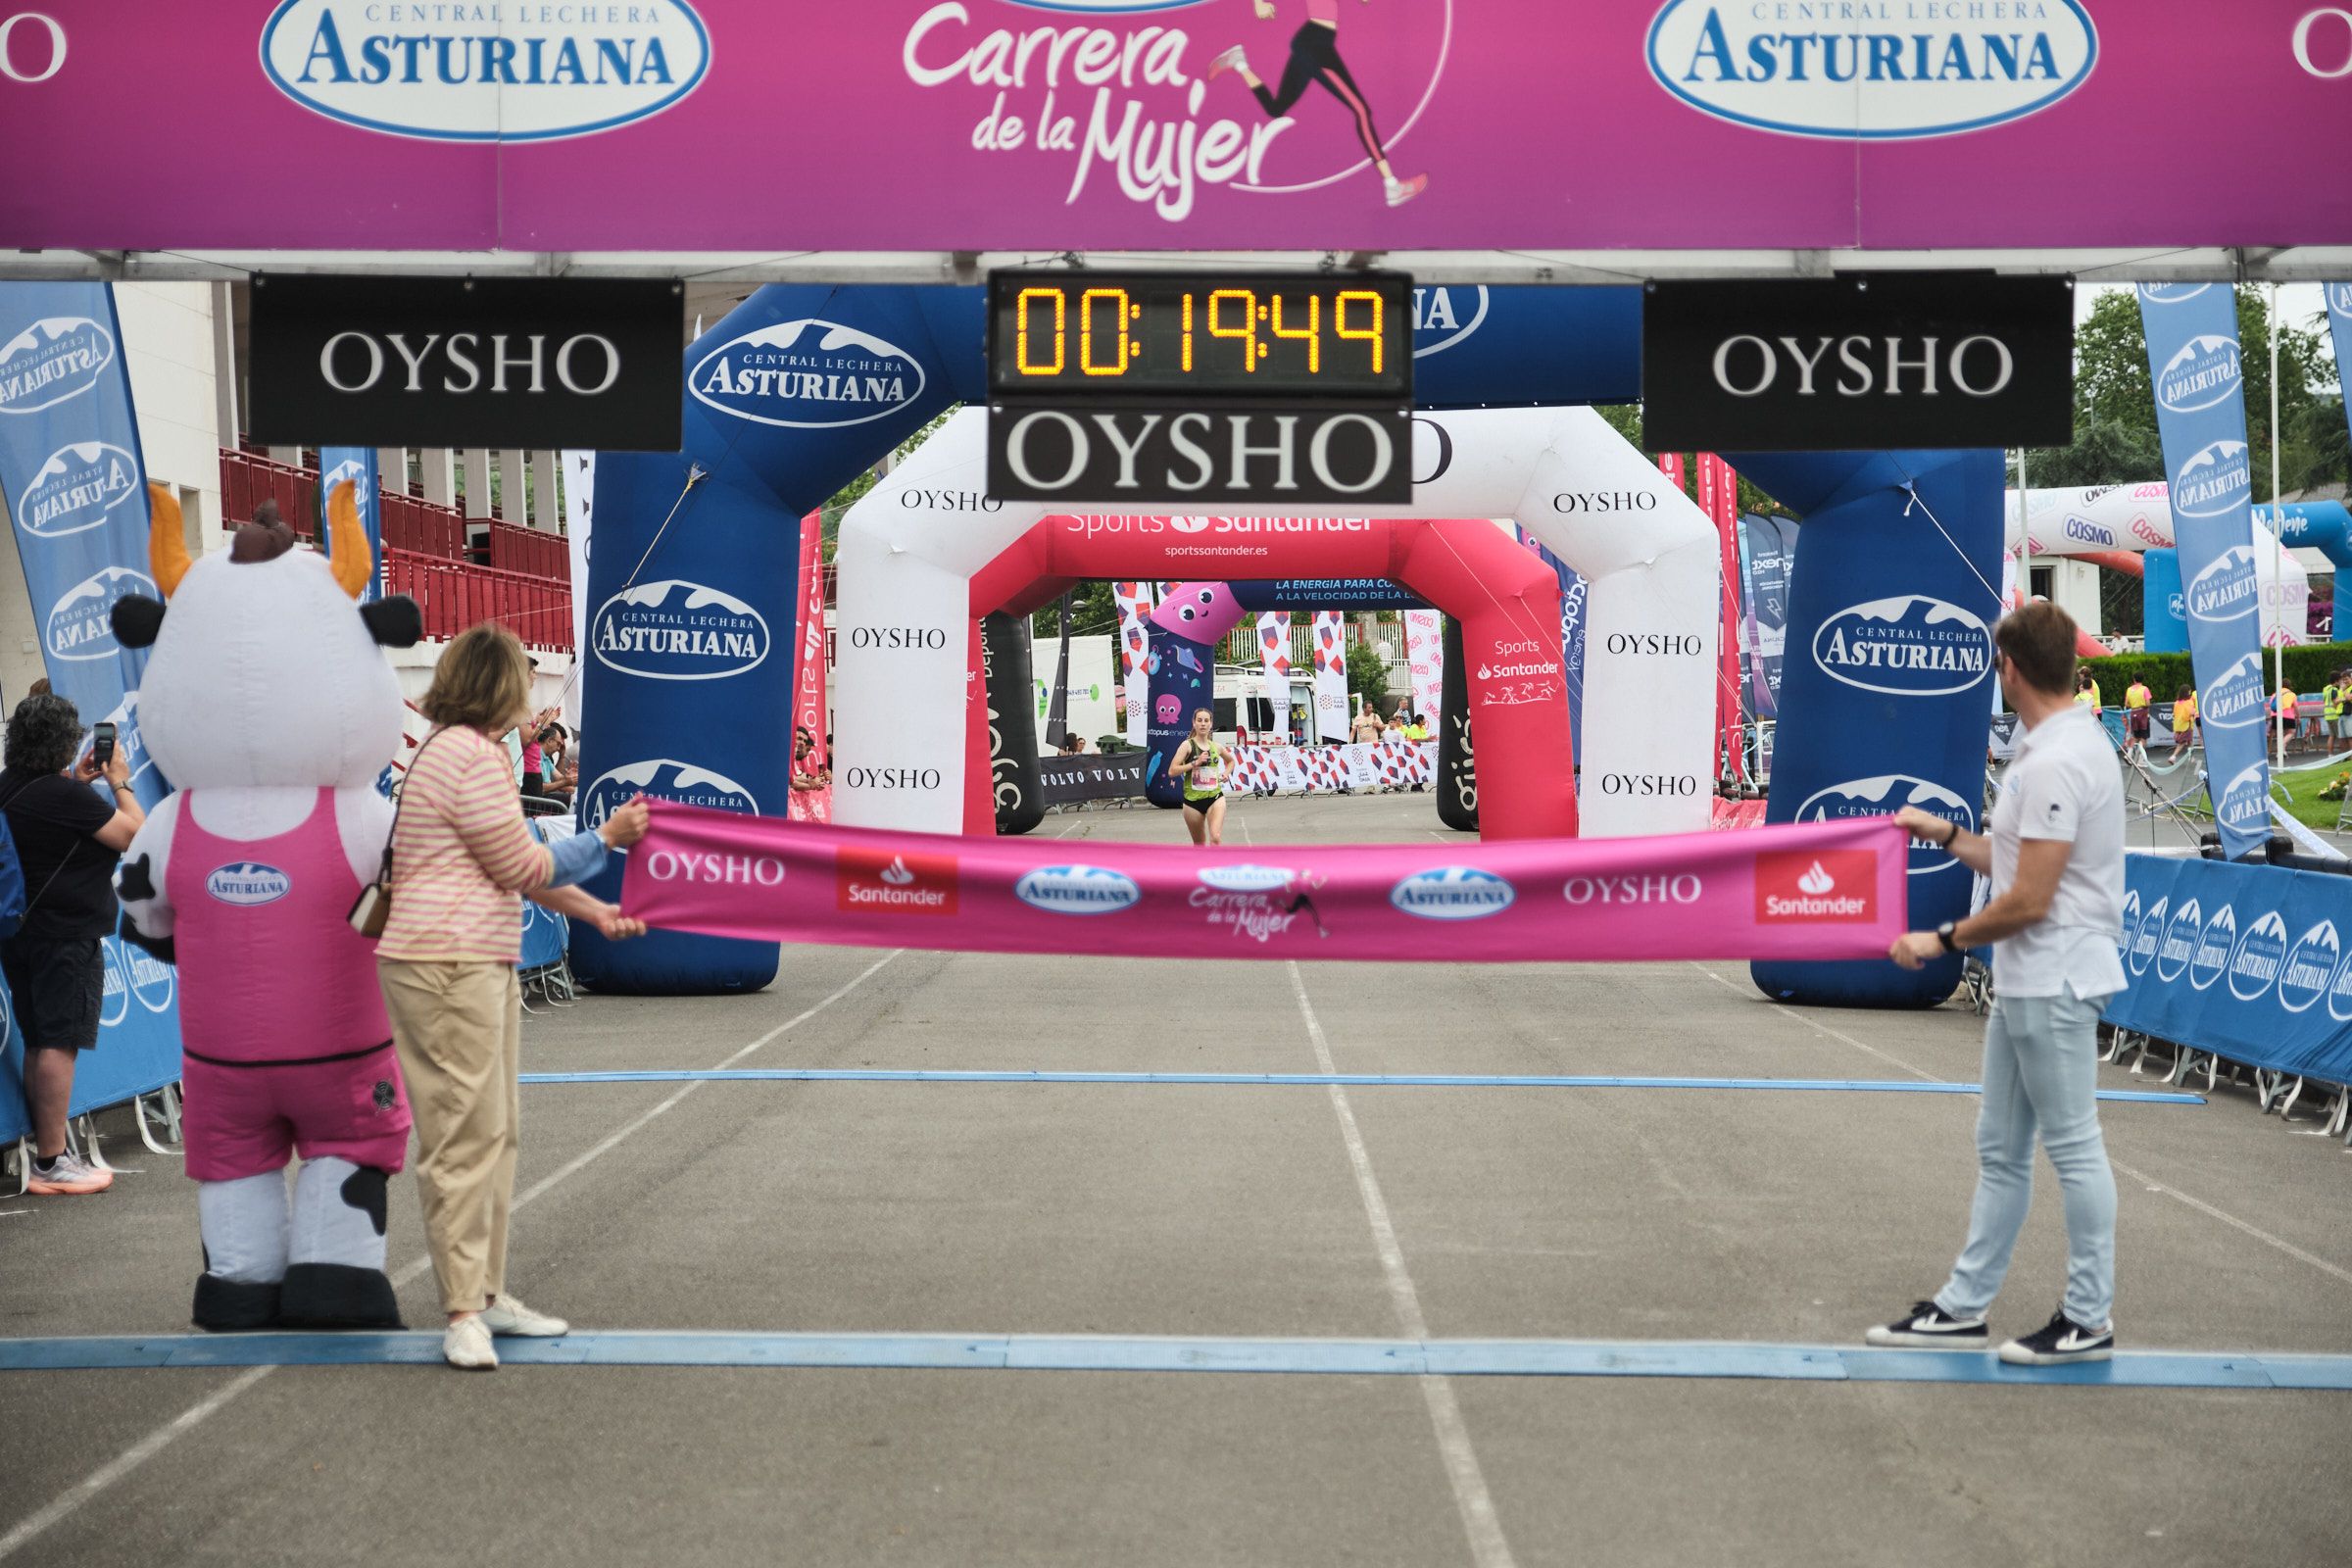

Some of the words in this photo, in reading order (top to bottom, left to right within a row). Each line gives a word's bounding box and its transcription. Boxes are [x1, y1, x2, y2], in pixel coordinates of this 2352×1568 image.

[366, 4, 503, 23] CENTRAL
[520, 6, 660, 24] LECHERA
[1752, 2, 1891, 21] CENTRAL
[1908, 1, 2048, 20] LECHERA
[297, 8, 676, 86] ASTURIANA
[1683, 7, 2063, 83] ASTURIANA
[970, 92, 1026, 151] de
[1036, 91, 1076, 151] la
[1066, 79, 1297, 221] Mujer
[1016, 287, 1384, 376] 00:19:49
[319, 330, 621, 395] OYSHO
[743, 354, 817, 368] CENTRAL
[825, 358, 903, 372] LECHERA
[1712, 334, 2014, 397] OYSHO
[702, 356, 906, 403] ASTURIANA
[1005, 411, 1394, 492] OYSHO
[1553, 491, 1657, 514] OYSHO
[2067, 517, 2114, 546] COSMO
[1164, 545, 1268, 557] sportssantander.es
[1344, 579, 1374, 589] PARA
[1286, 592, 1300, 601] LA
[1303, 592, 1367, 601] VELOCIDAD
[1370, 591, 1385, 600] DE
[622, 612, 684, 625] CENTRAL
[690, 614, 755, 629] LECHERA
[599, 613, 759, 660] ASTURIANA
[852, 626, 946, 650] OYSHO
[1606, 633, 1702, 657] OYSHO
[1856, 626, 1924, 641] CENTRAL
[1930, 629, 1984, 644] LECHERA
[1494, 640, 1540, 657] Sports
[1824, 626, 1984, 672] ASTURIANA
[1493, 661, 1559, 678] Santander
[847, 766, 941, 790] OYSHO
[1041, 770, 1085, 787] VOLVO
[1601, 773, 1697, 797] OYSHO
[679, 795, 743, 808] LECHERA
[648, 851, 785, 886] OYSHO
[211, 877, 284, 894] ASTURIANA
[848, 884, 945, 906] Santander
[1024, 881, 1132, 903] ASTURIANA
[1397, 885, 1508, 906] ASTURIANA
[1562, 874, 1702, 905] OYSHO
[1766, 894, 1866, 916] Santander
